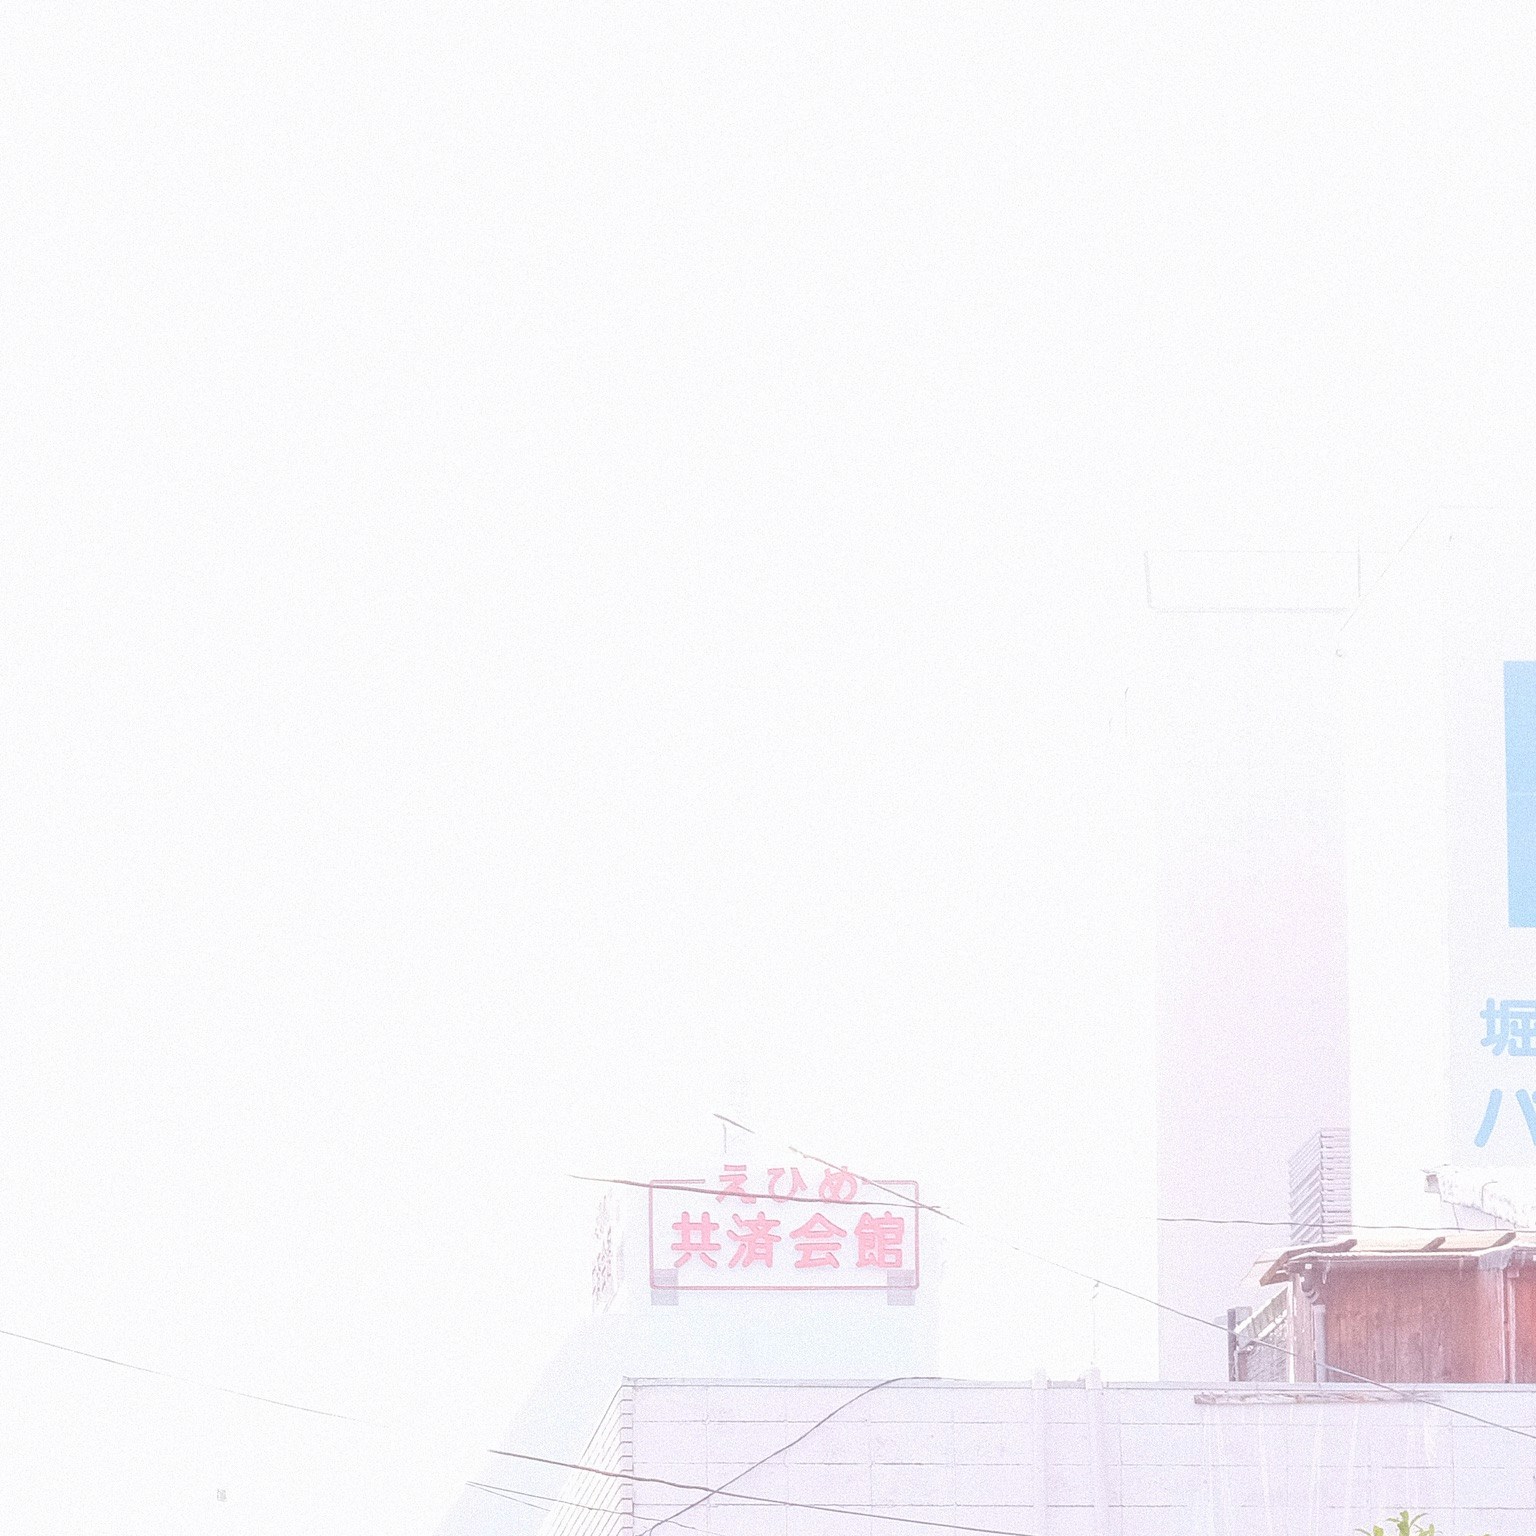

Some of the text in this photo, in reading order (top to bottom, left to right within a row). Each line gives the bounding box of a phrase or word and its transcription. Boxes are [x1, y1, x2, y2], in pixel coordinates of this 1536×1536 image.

[715, 1164, 860, 1205] えひめ
[671, 1211, 904, 1269] 共済会館
